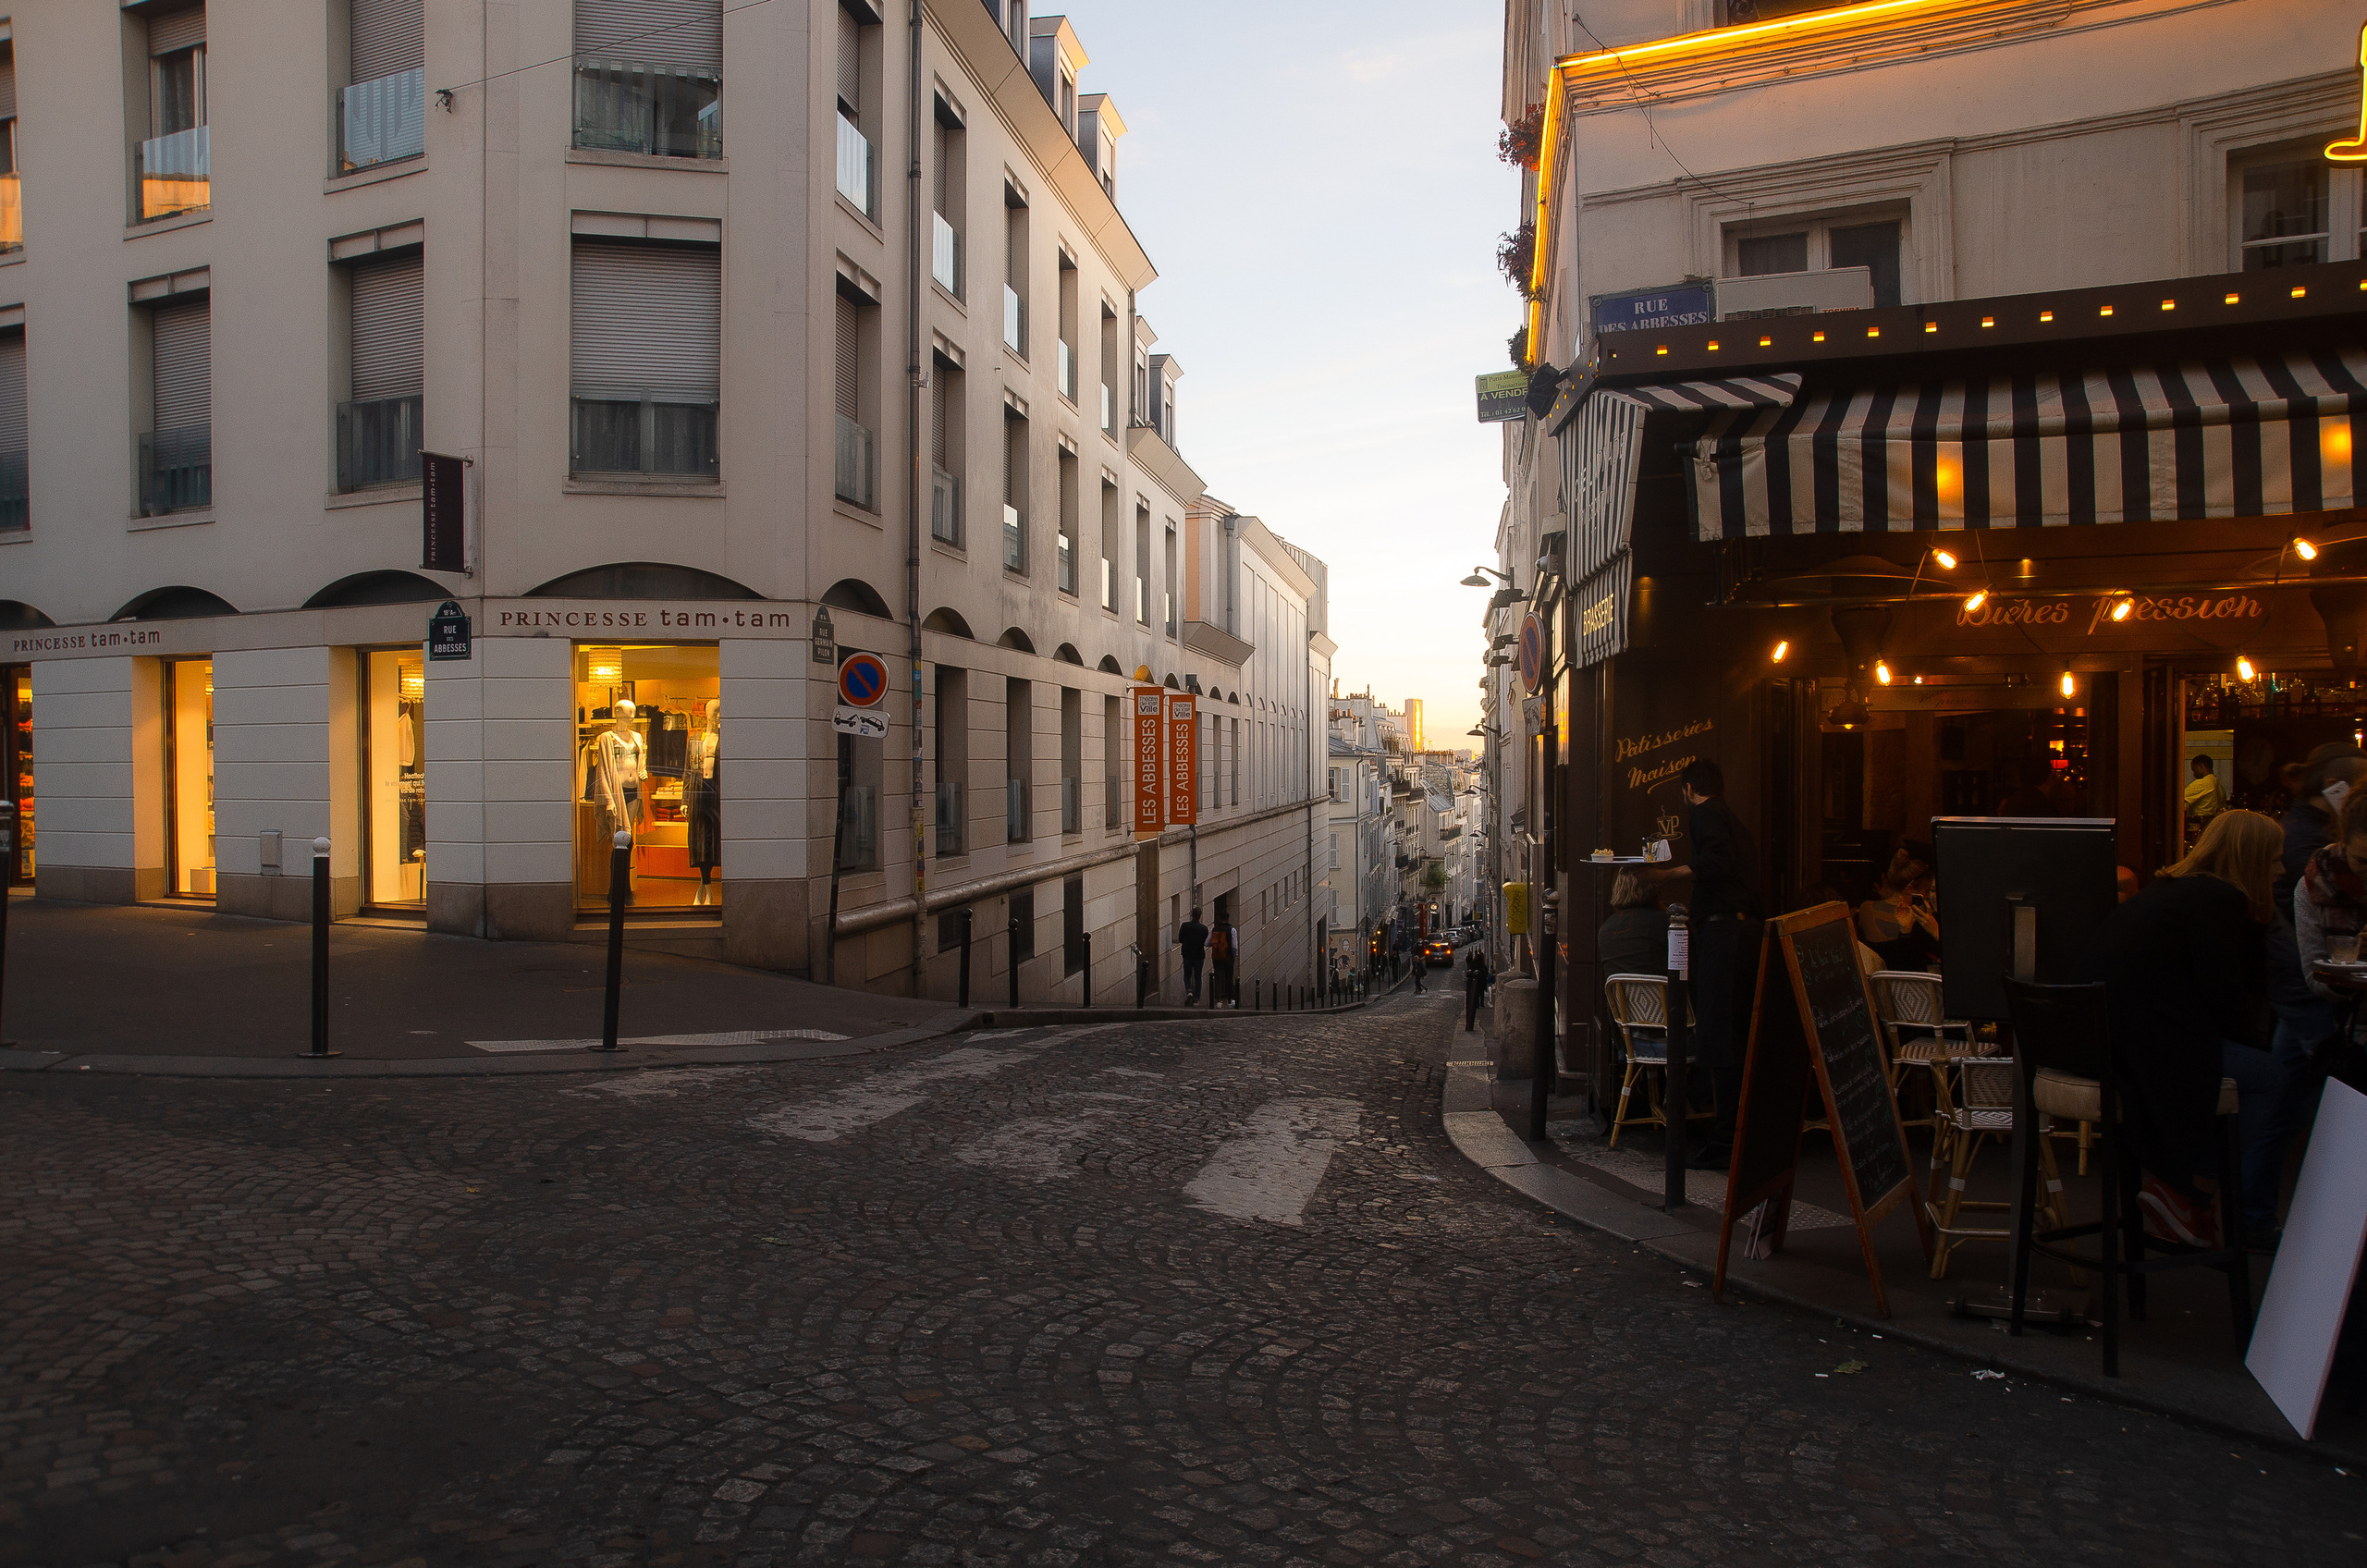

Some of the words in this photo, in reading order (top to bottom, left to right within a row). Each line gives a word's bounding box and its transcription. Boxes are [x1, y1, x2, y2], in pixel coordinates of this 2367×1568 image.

[1634, 299, 1668, 314] RUE
[1631, 312, 1707, 330] ABBESSES
[1490, 388, 1528, 399] VENDR
[500, 611, 647, 627] PRINCESSE
[1583, 593, 1614, 636] BRASSERIE
[2087, 595, 2263, 636] pession
[444, 625, 457, 634] RUE
[13, 635, 86, 652] PRINCESSE
[435, 643, 467, 653] ABBESSES
[1142, 718, 1156, 795] ABBESSES
[1175, 723, 1189, 791] ABBESSES
[1627, 755, 1696, 789] Maison
[1142, 799, 1157, 824] LES
[1176, 795, 1189, 817] LES
